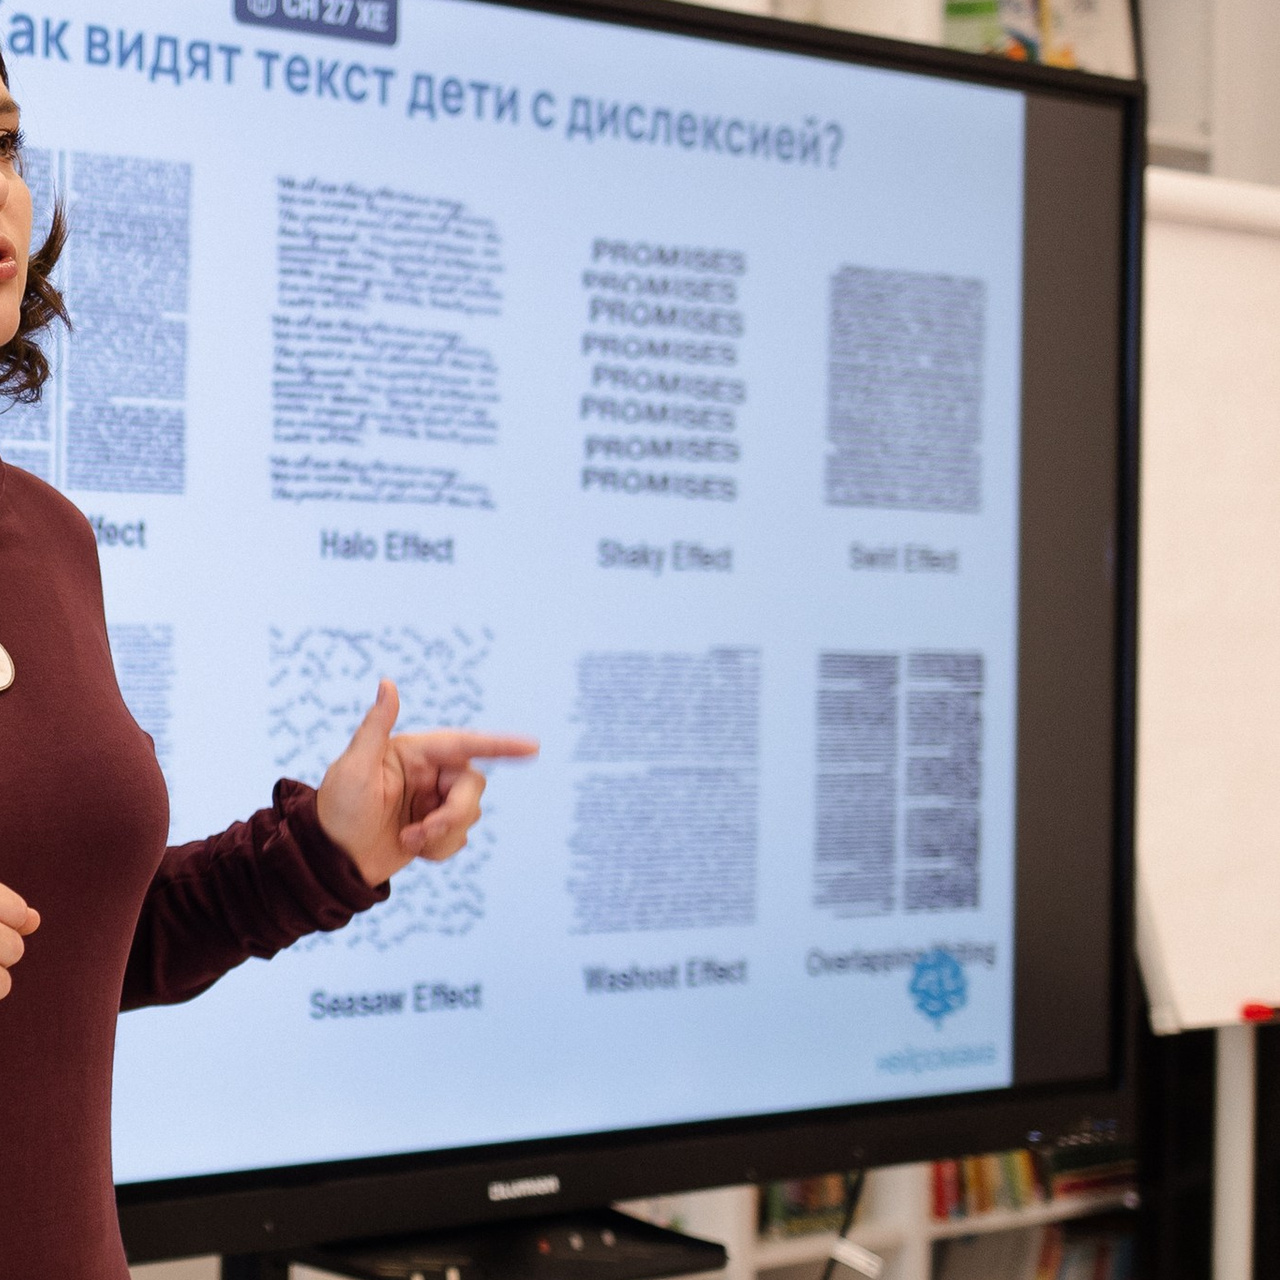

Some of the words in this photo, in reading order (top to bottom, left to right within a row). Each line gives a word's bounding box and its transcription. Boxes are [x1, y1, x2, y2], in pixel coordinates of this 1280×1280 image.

[86, 23, 243, 86] видят
[254, 49, 396, 105] текст
[407, 73, 518, 122] дети
[531, 91, 557, 129] с
[567, 95, 846, 168] дислексией?
[592, 237, 746, 277] PROMISES
[582, 270, 738, 306] PROMISES
[589, 295, 745, 338] PROMISES
[581, 331, 738, 367] PROMISES
[592, 365, 747, 405] PROMISES
[580, 393, 737, 433] PROMISES
[585, 434, 741, 463] PROMISES
[581, 467, 738, 503] PROMISES
[320, 529, 378, 560] Halo
[384, 531, 454, 563] Effect
[597, 538, 664, 578] Shaky
[672, 540, 733, 573] Effect
[904, 543, 959, 573] Effect
[685, 956, 748, 988] Effect
[414, 982, 482, 1012] Effect
